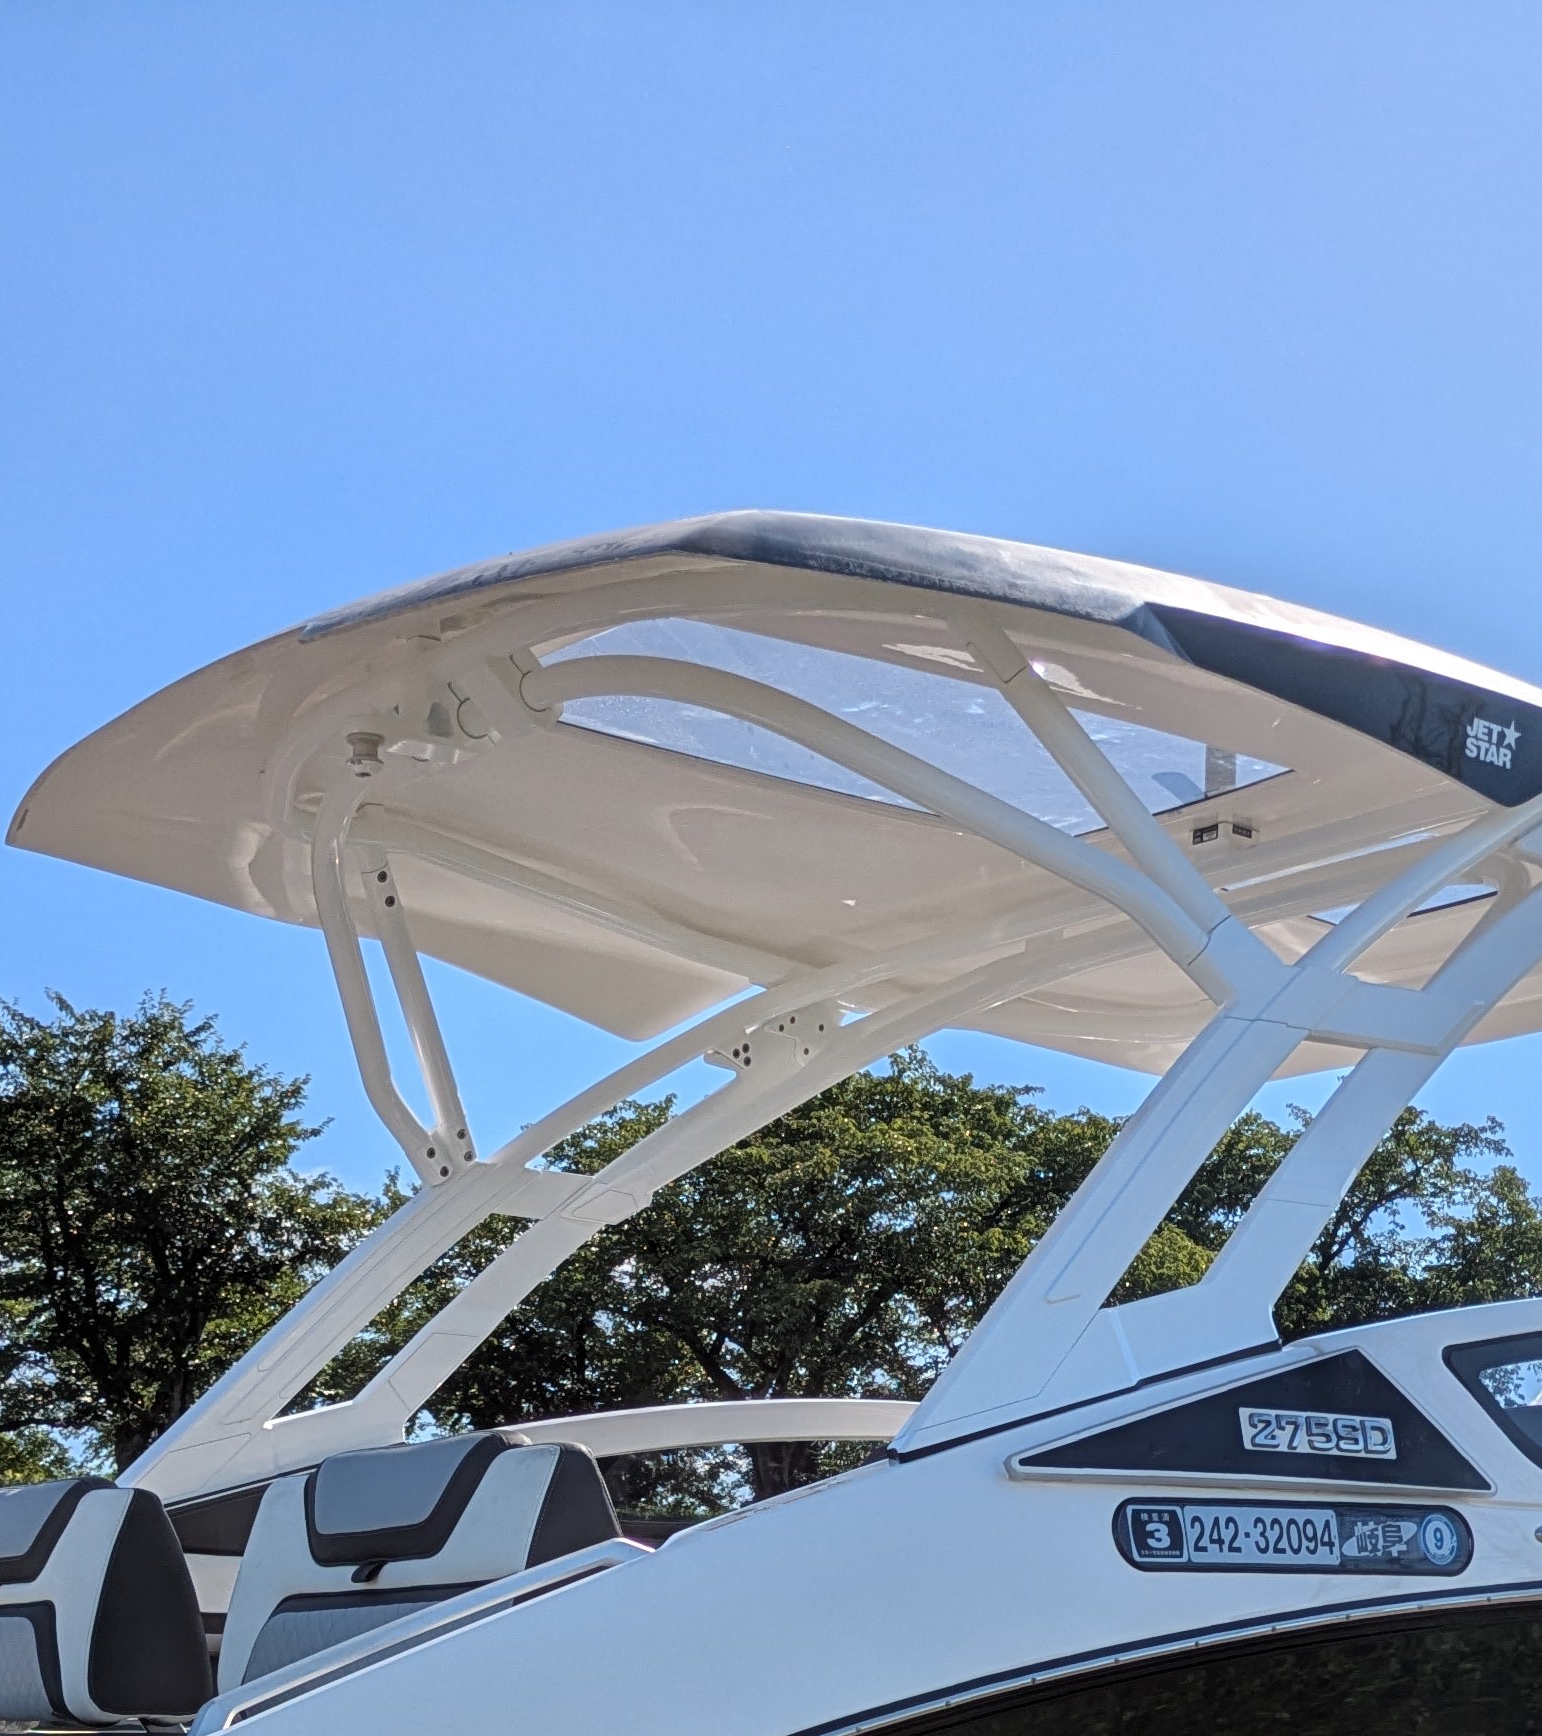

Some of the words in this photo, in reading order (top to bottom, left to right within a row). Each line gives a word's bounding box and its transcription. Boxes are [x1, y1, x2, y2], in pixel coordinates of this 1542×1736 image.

[1466, 717, 1503, 745] JET
[1465, 737, 1512, 770] STAR
[1248, 1412, 1394, 1455] 275SD
[1145, 1522, 1171, 1549] 3
[1353, 1521, 1408, 1557] 岐阜
[1433, 1527, 1445, 1551] 9
